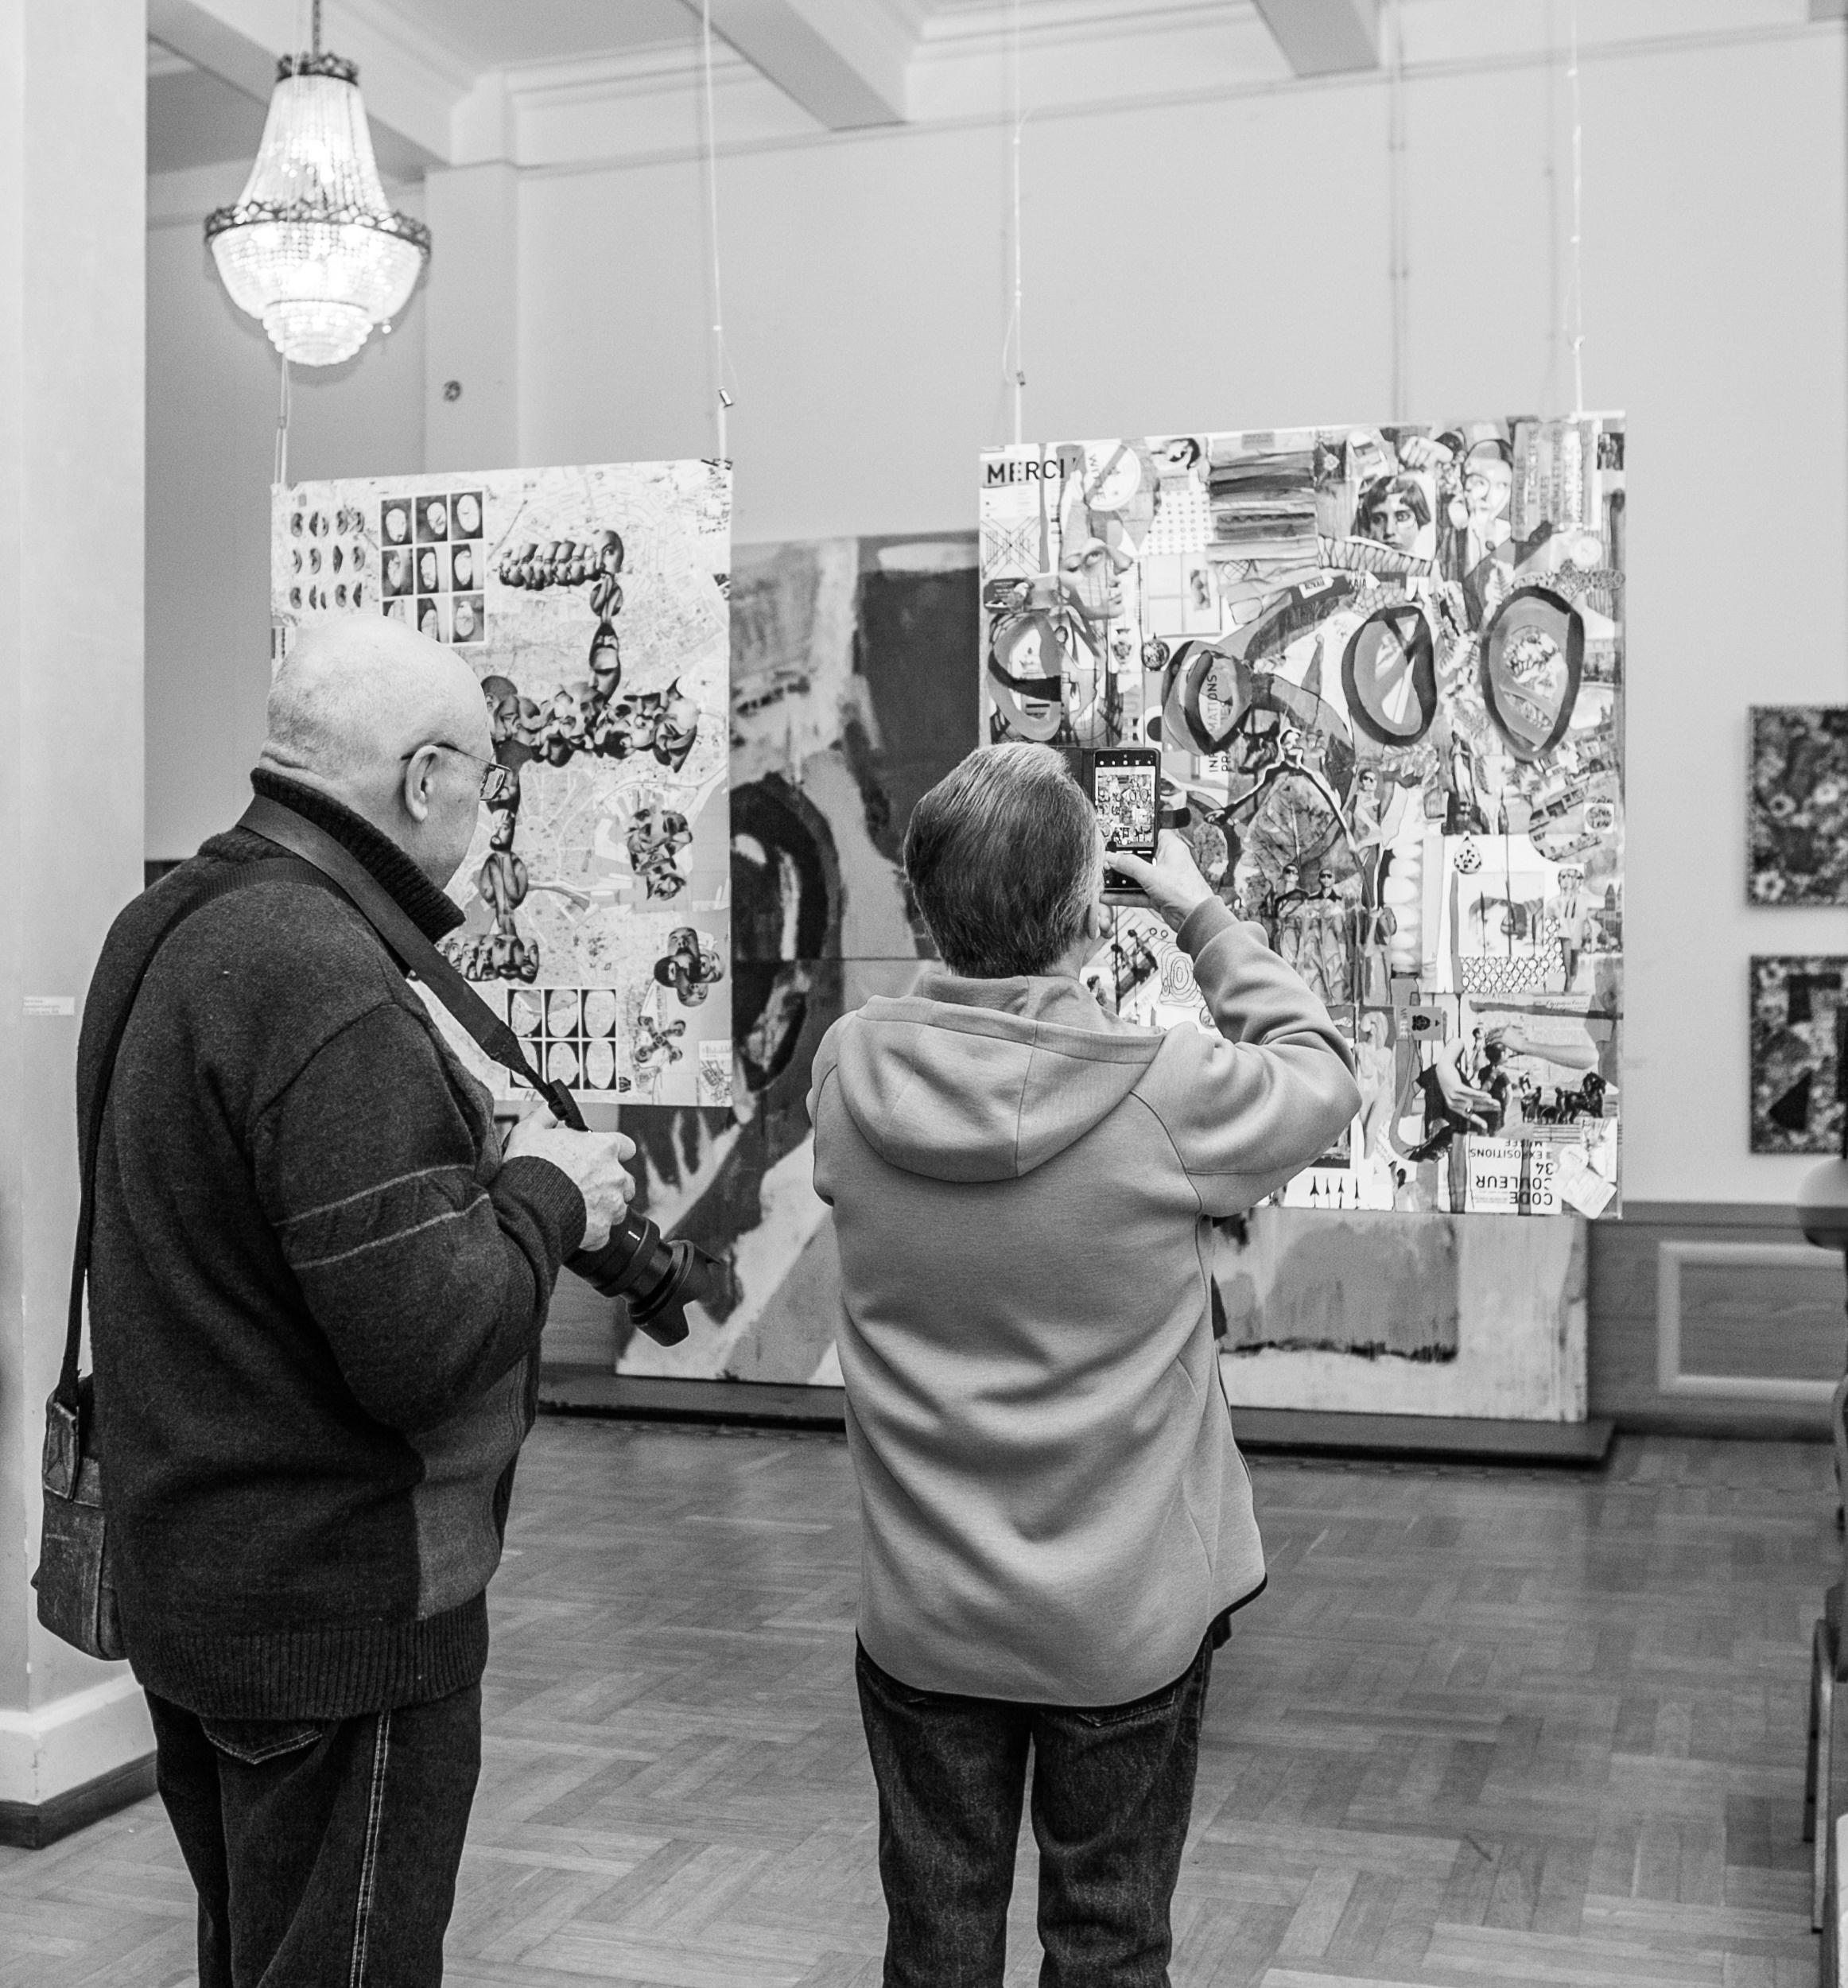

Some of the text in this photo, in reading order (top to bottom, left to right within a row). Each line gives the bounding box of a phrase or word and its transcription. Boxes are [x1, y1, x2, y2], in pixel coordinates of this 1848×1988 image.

[1206, 674, 1218, 772] INFMATIONS
[1469, 1149, 1543, 1159] EXOSITIONS
[1535, 1162, 1554, 1175] 34
[1509, 1191, 1553, 1206] CODE
